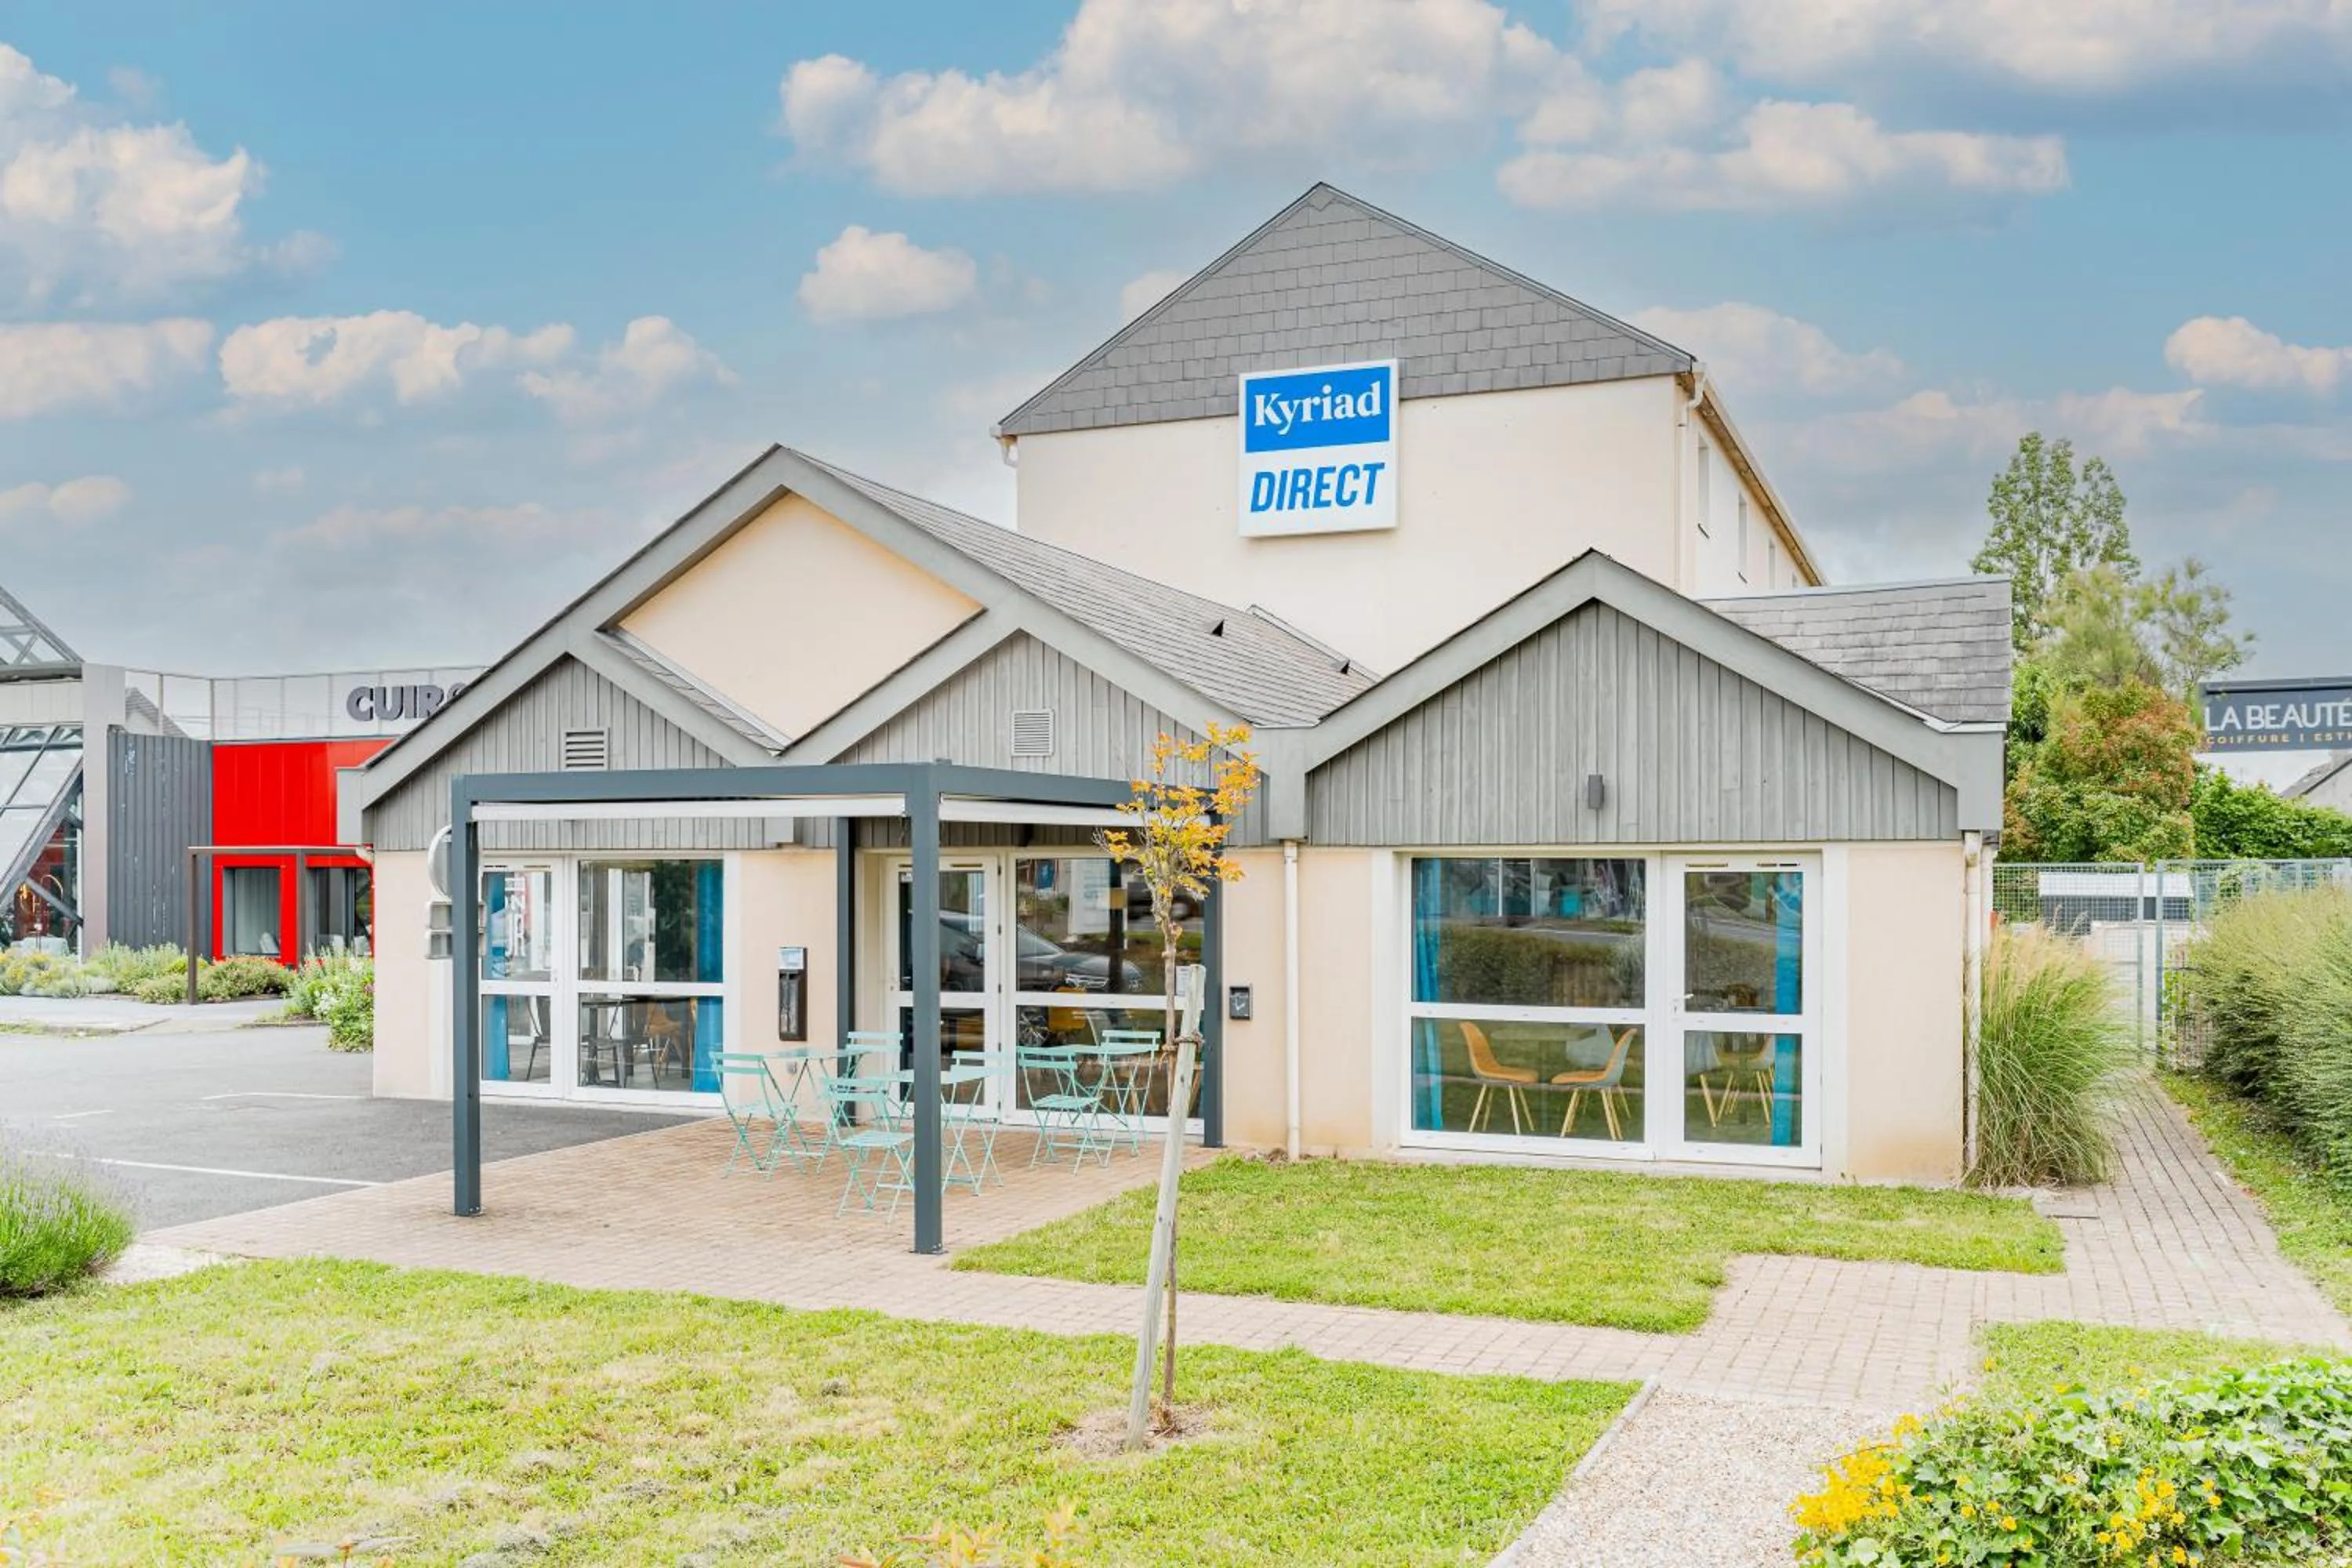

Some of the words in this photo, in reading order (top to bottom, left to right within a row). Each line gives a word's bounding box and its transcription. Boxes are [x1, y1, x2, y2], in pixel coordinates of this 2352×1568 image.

[1254, 381, 1381, 435] Kyriad
[1250, 462, 1385, 512] DIRECT
[2205, 706, 2242, 731] LA
[2246, 697, 2352, 731] BEAUTÉ
[2206, 734, 2290, 744] COIFFURE
